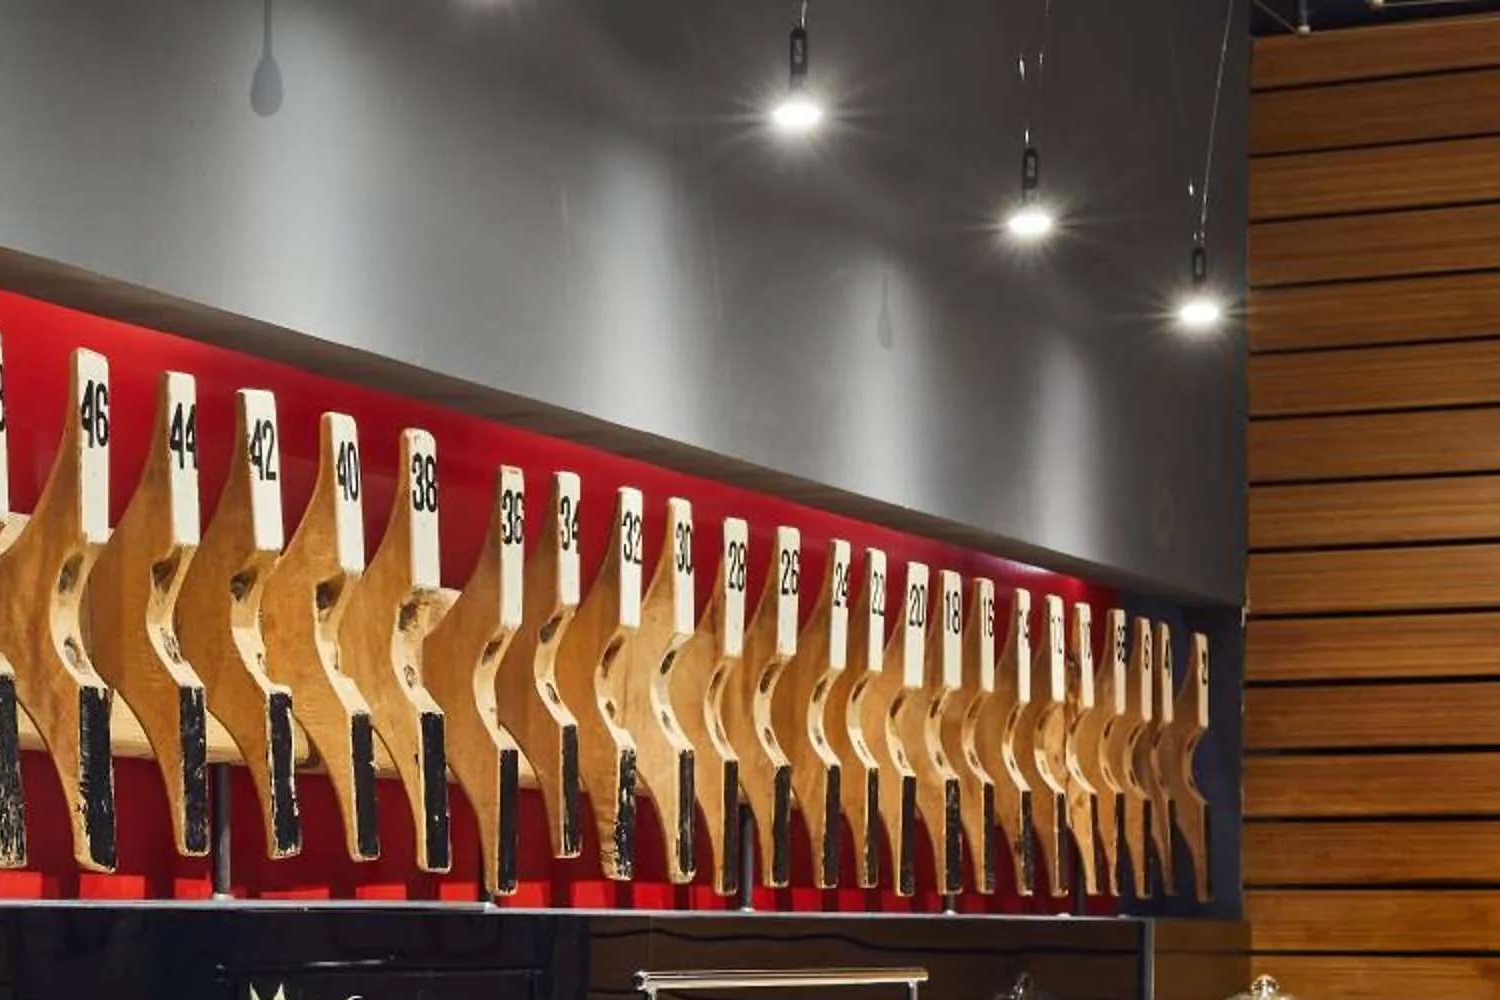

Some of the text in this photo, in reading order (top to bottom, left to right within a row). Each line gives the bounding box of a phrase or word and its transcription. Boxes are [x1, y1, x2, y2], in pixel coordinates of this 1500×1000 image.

[80, 380, 108, 448] 46
[169, 402, 198, 469] 44
[249, 419, 276, 480] 42
[336, 441, 359, 501] 40
[412, 452, 437, 512] 38
[501, 489, 523, 544] 36
[559, 496, 580, 554] 34
[621, 511, 642, 565] 32
[675, 522, 693, 575] 30
[728, 541, 746, 592] 28
[781, 549, 799, 595] 26
[946, 591, 961, 634] 18
